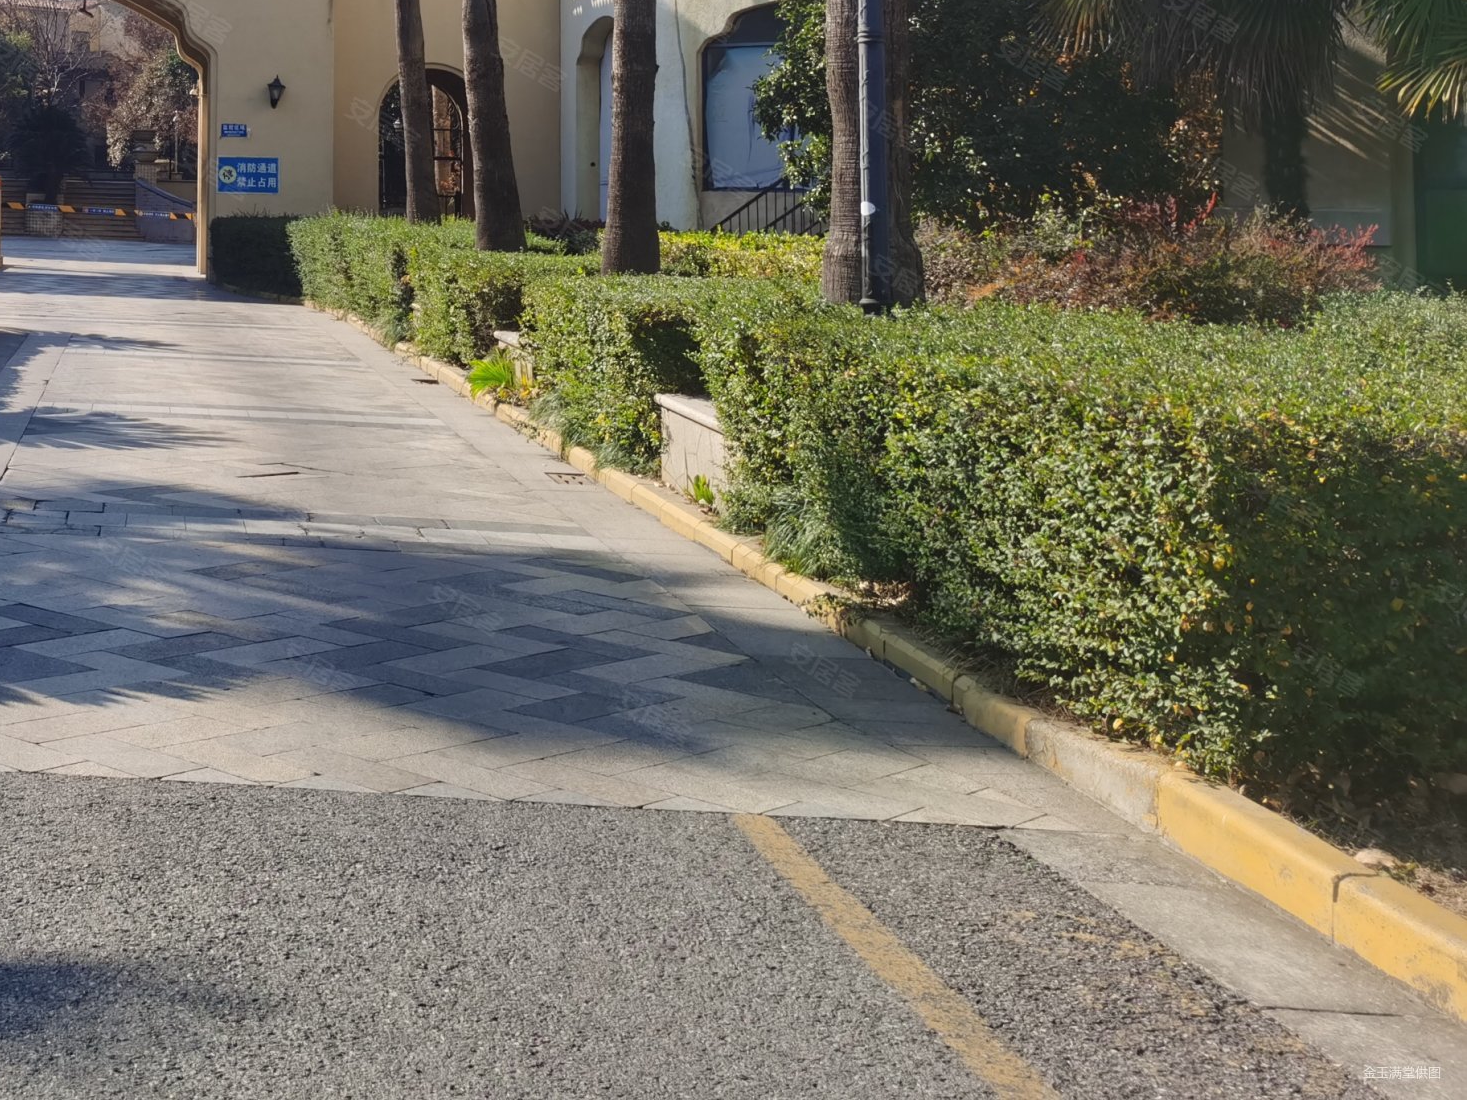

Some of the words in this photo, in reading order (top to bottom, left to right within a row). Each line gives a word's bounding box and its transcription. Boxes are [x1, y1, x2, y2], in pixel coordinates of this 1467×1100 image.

[237, 162, 277, 174] 消防通道
[237, 176, 277, 188] 禁止占用
